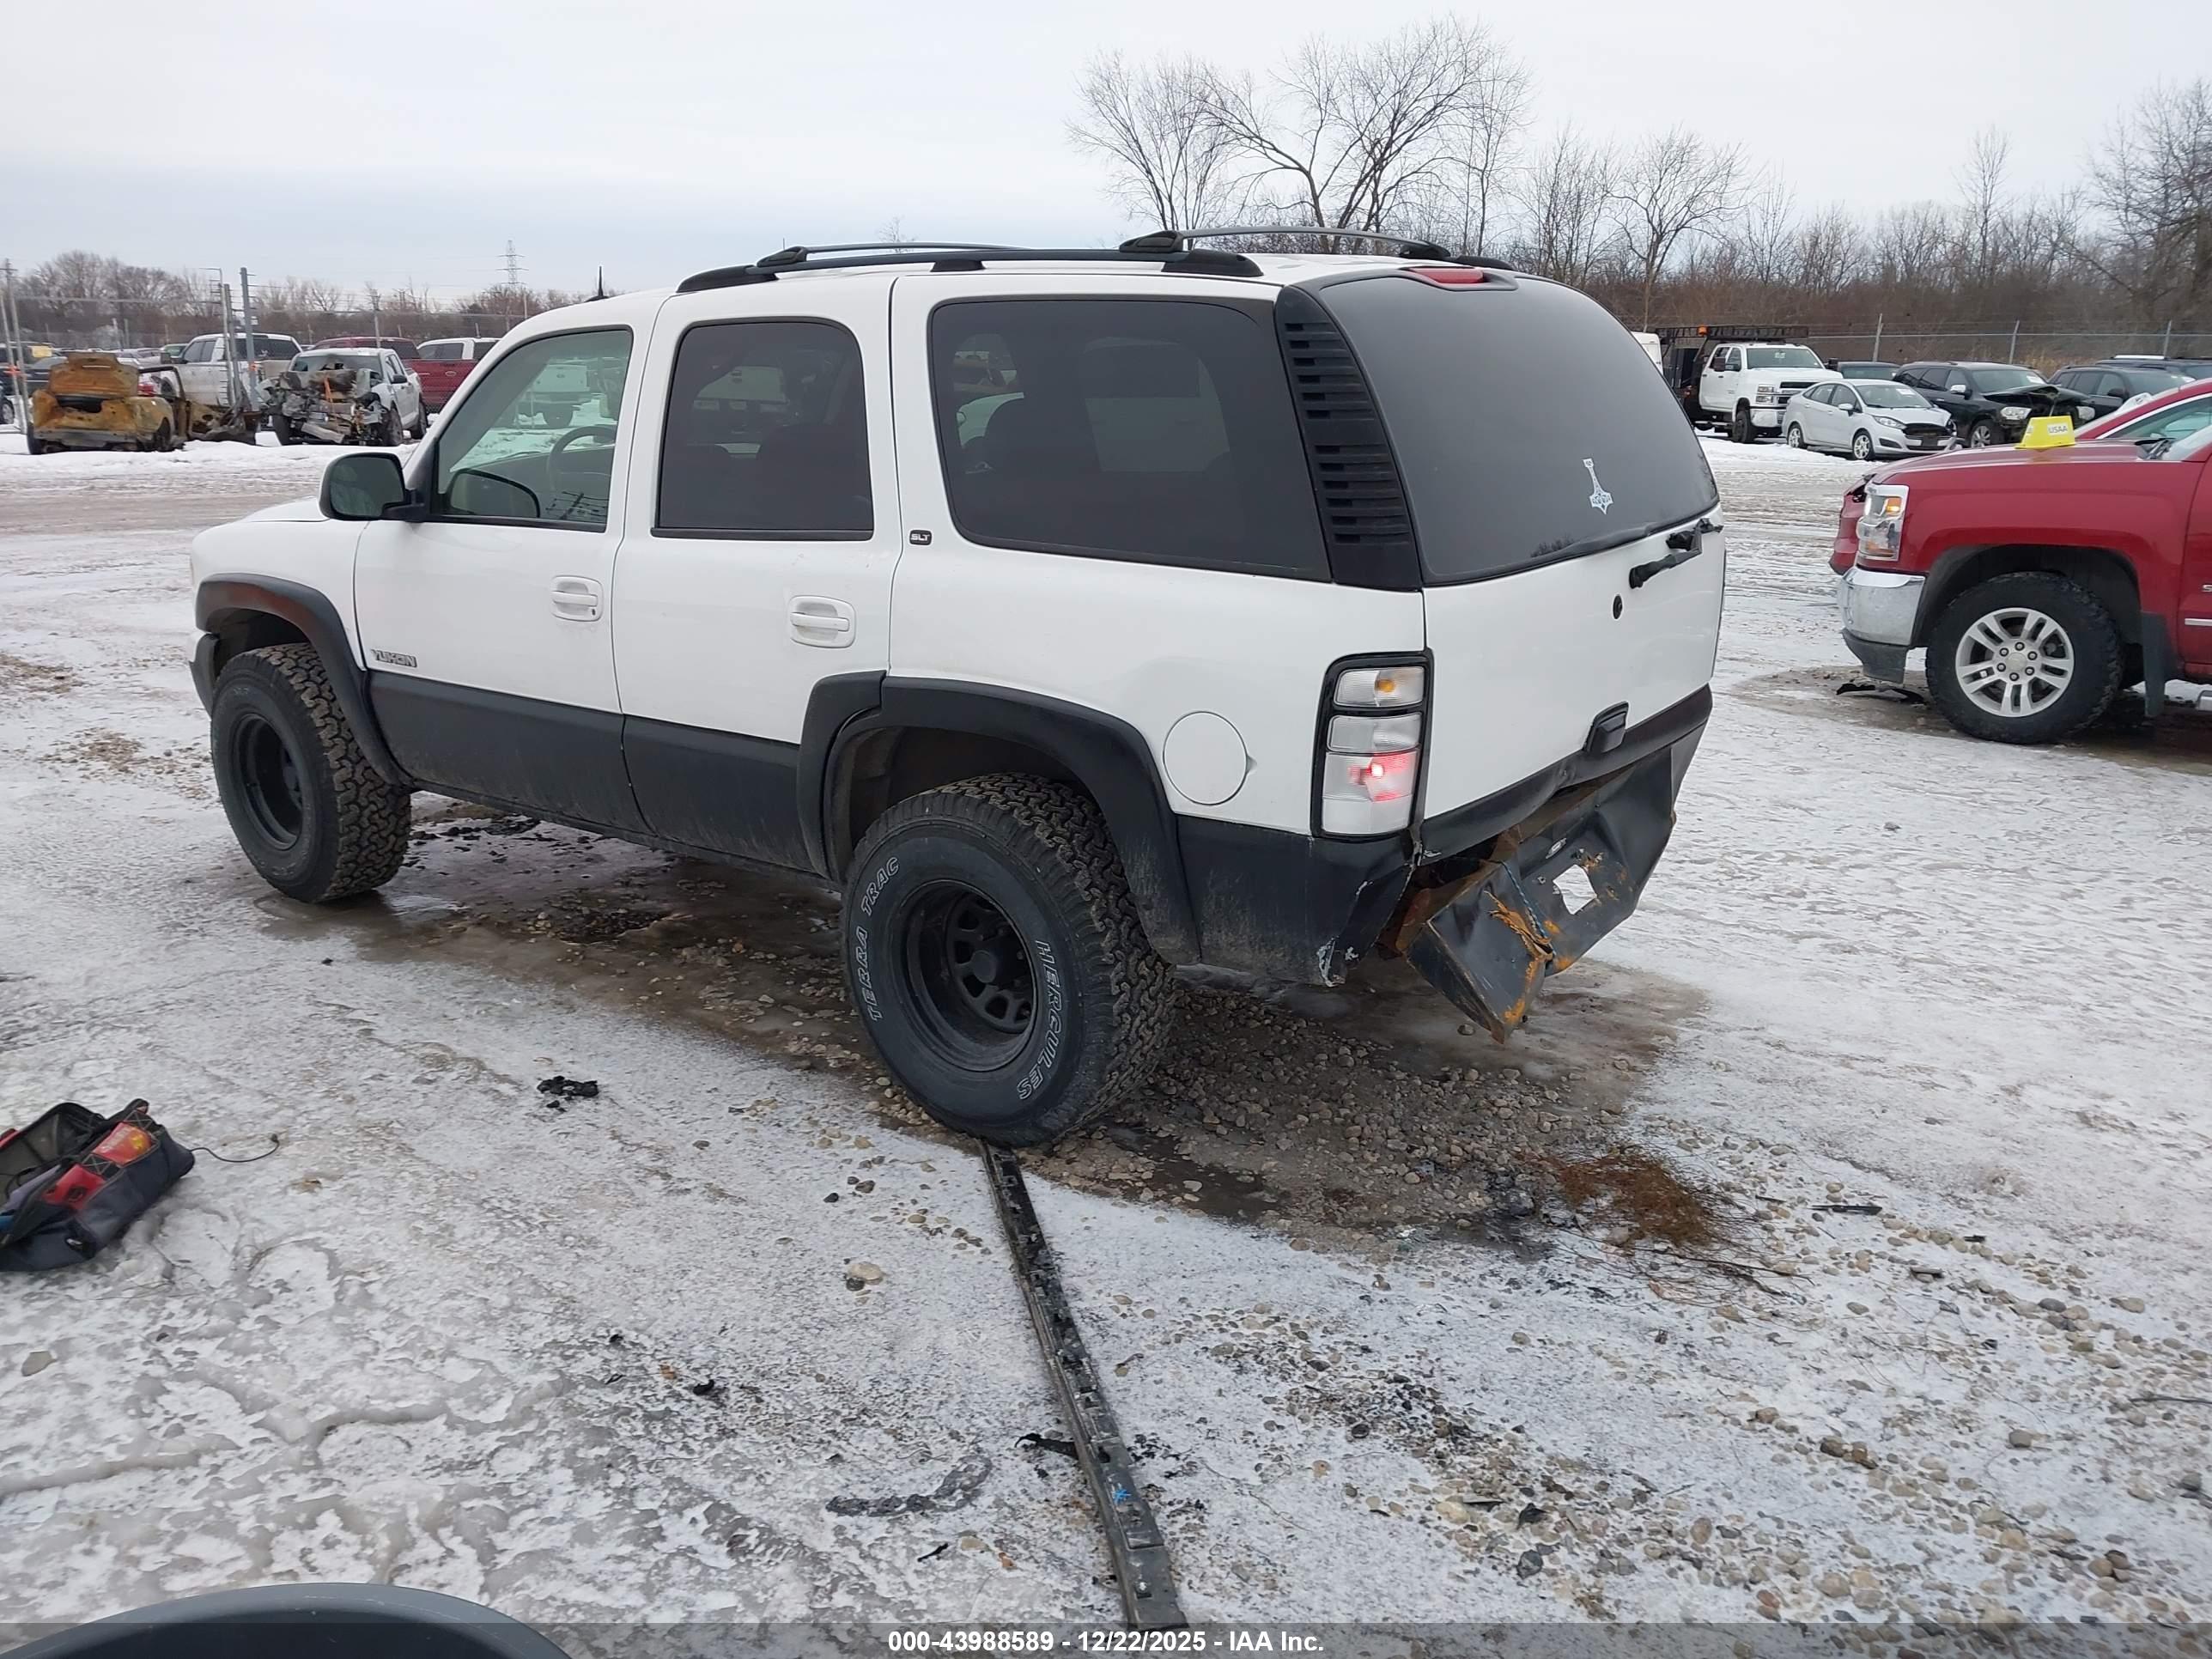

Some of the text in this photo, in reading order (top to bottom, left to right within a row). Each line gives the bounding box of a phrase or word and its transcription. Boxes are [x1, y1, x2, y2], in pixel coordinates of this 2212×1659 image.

[2048, 425, 2068, 434] USAA
[910, 532, 931, 542] SLT
[855, 857, 899, 1022] TERRA TRAC
[1017, 939, 1062, 1099] HERCULES
